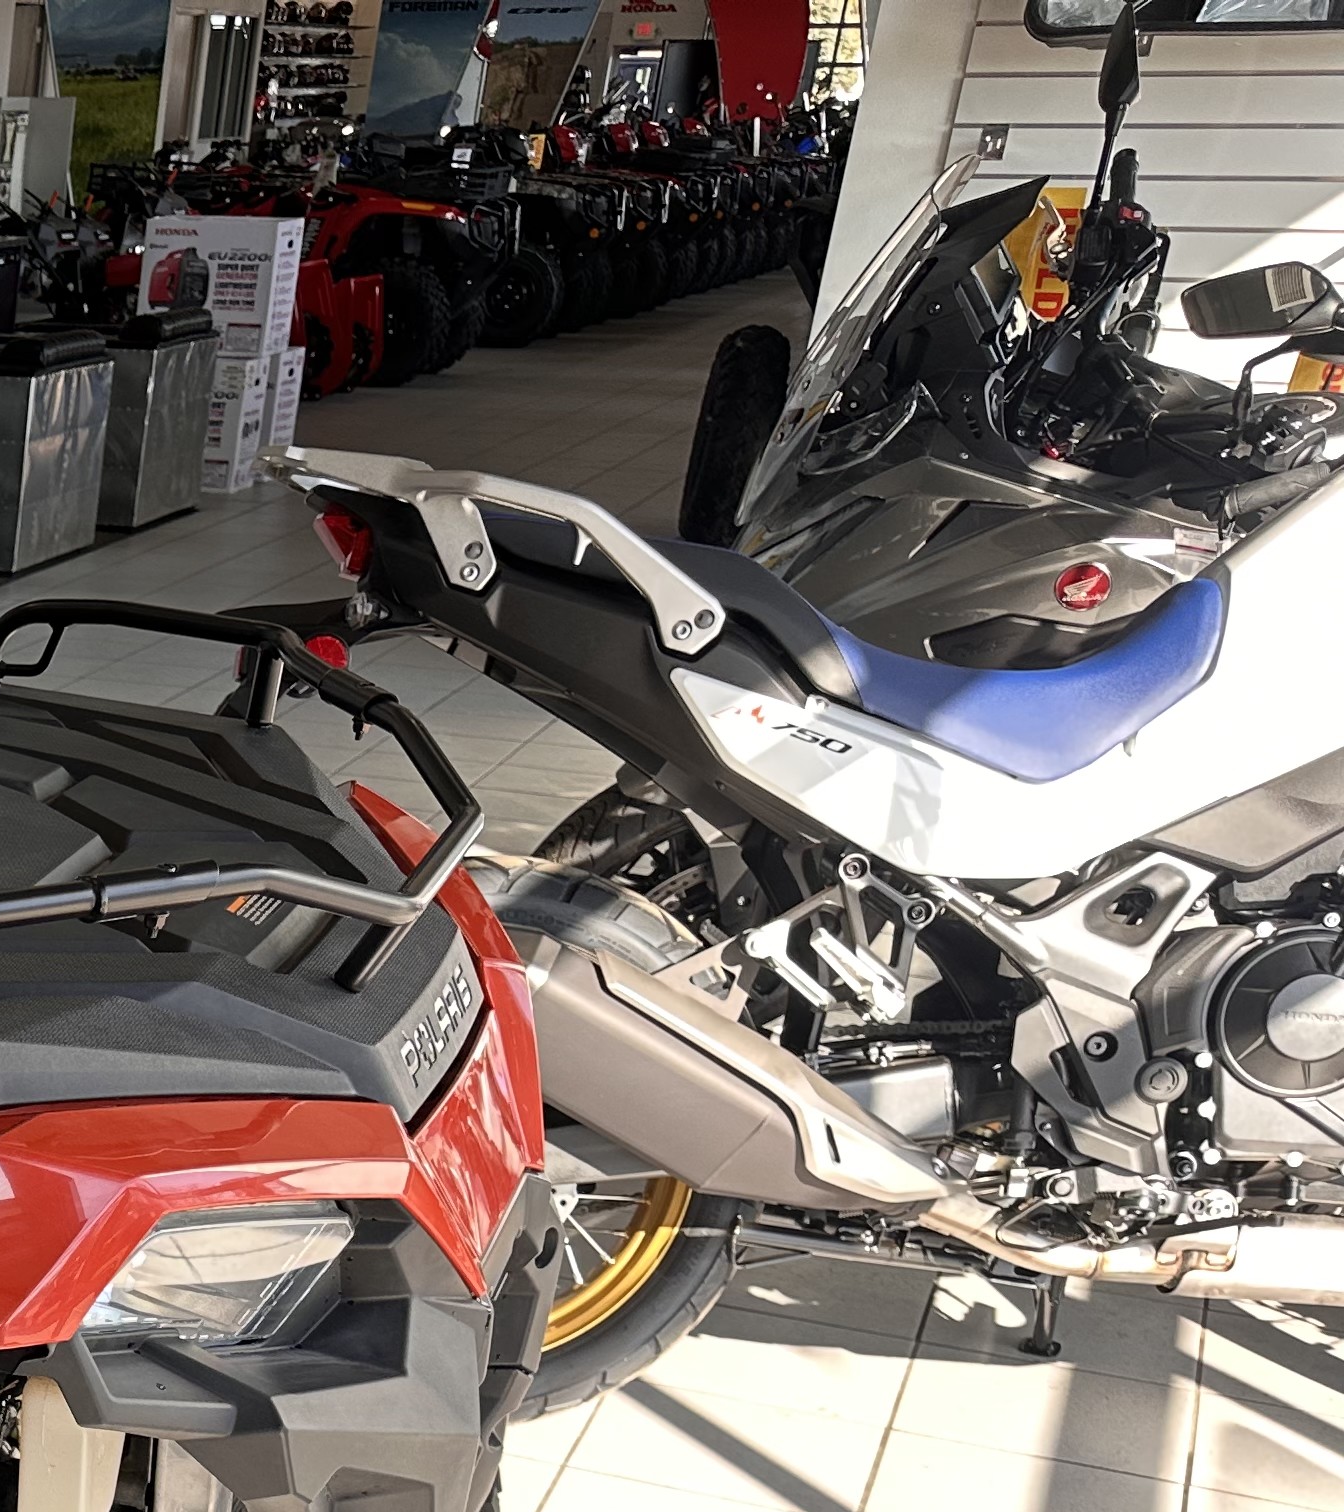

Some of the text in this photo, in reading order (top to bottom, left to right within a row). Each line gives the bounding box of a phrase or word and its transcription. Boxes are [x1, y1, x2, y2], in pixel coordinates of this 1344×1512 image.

[388, 0, 479, 12] FOREMAN
[621, 4, 677, 13] HONDA
[155, 228, 199, 237] HONDA
[400, 962, 473, 1089] POLARIS
